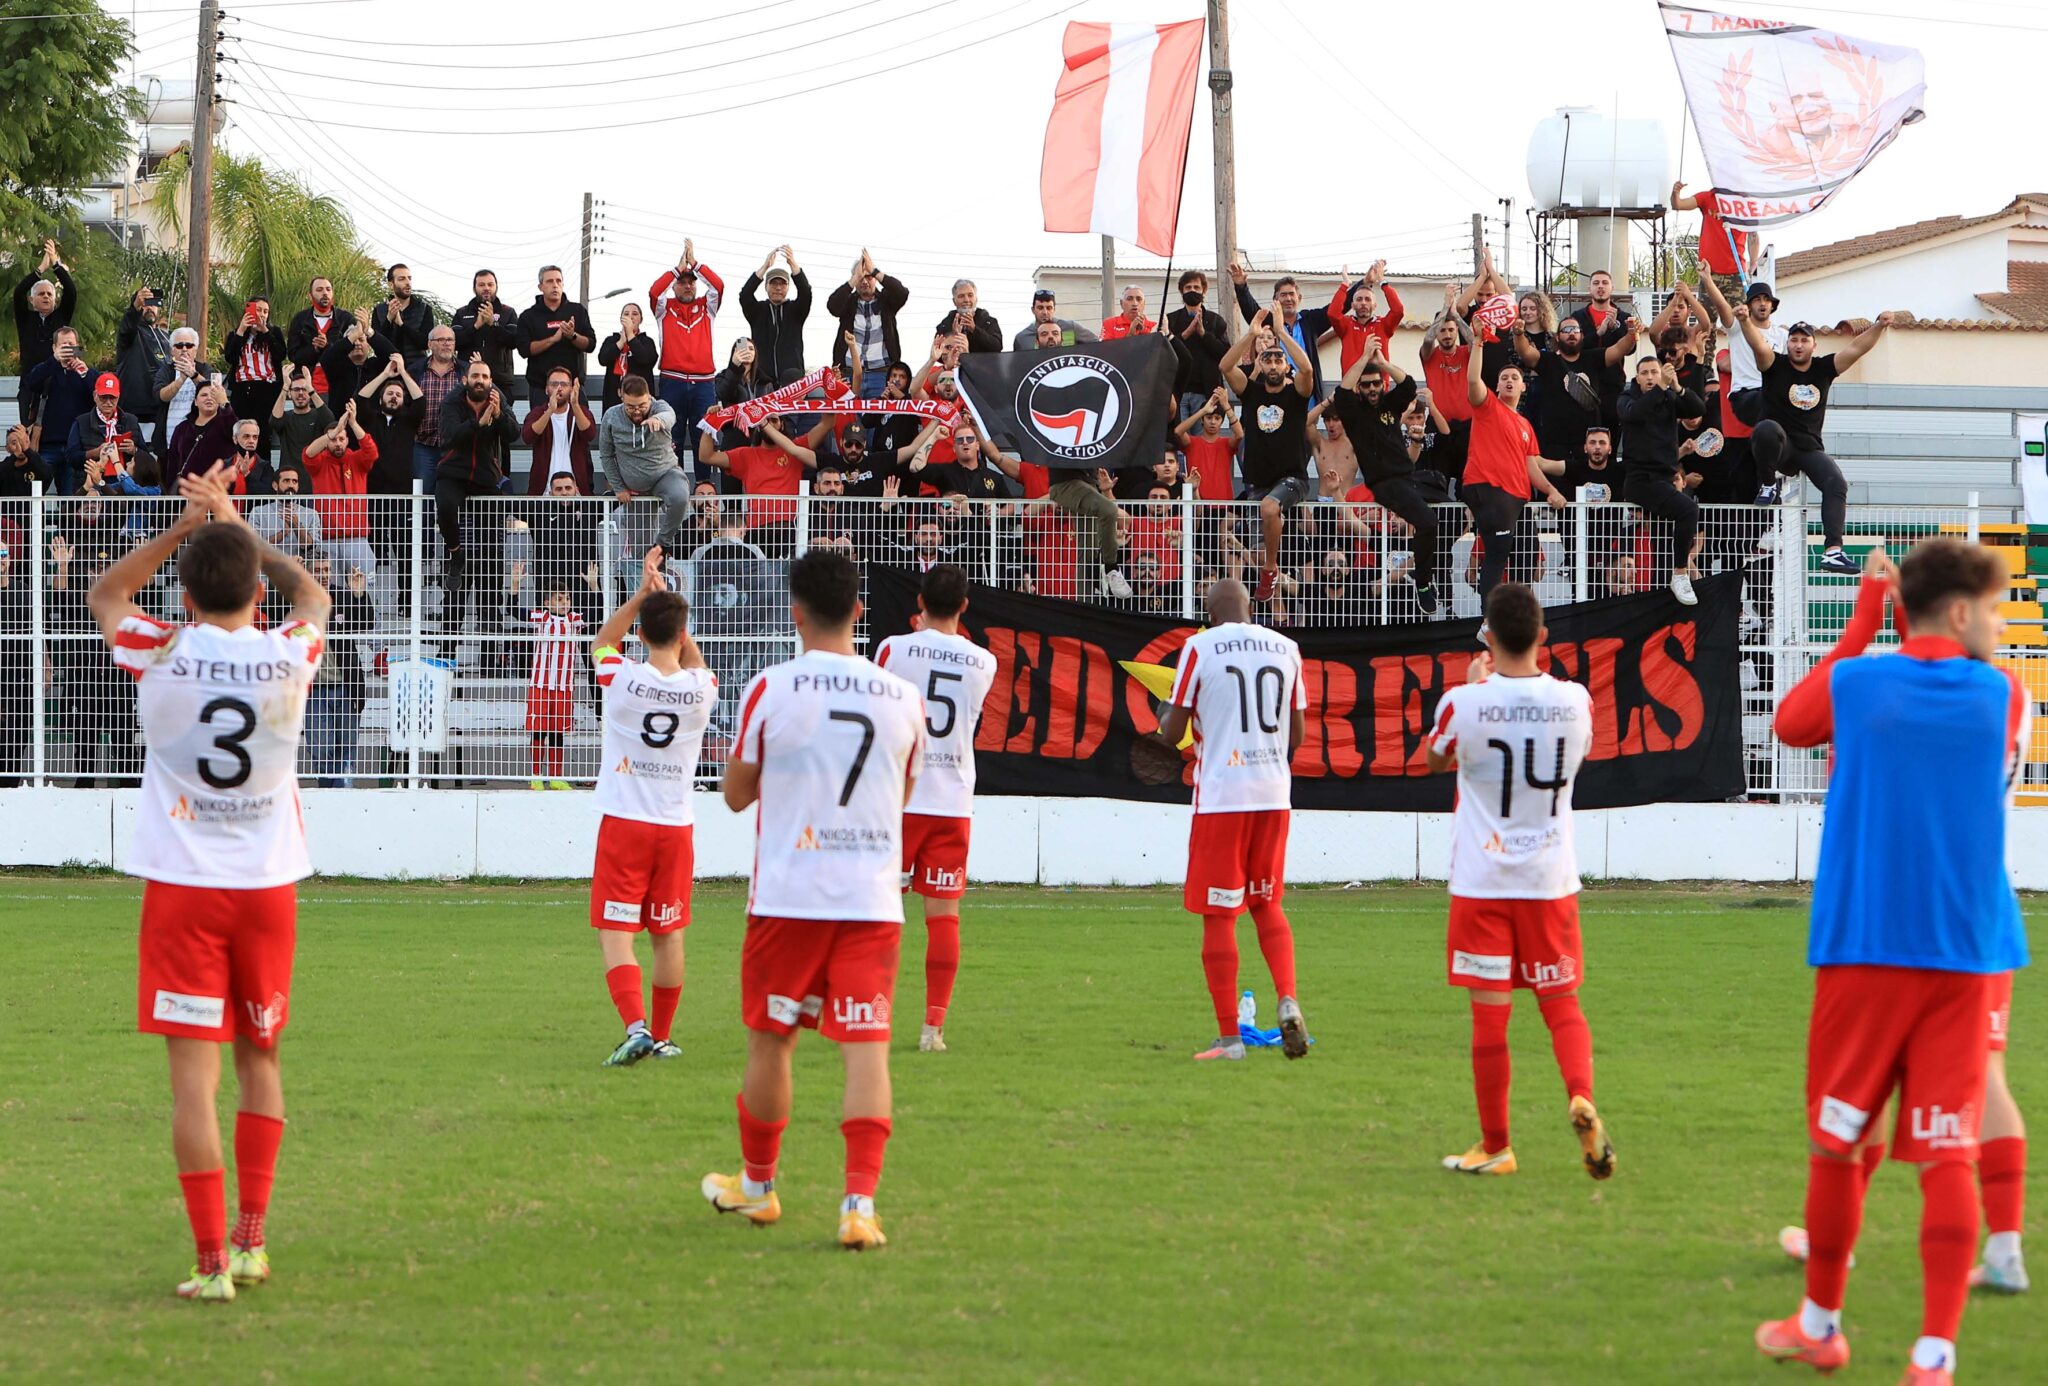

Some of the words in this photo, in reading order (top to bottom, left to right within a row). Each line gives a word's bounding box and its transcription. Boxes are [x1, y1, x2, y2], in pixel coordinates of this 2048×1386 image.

[1718, 198, 1798, 217] DREAM
[1028, 357, 1115, 386] ANTIFASCIST
[1054, 441, 1107, 458] ACTION
[908, 645, 985, 670] ANDREOU
[1214, 638, 1287, 655] DANILO
[172, 656, 292, 682] STELIOS
[627, 680, 704, 705] LEMESIOS
[793, 674, 903, 700] PAVLOU
[1225, 665, 1284, 734] 10
[925, 669, 962, 738] 5
[1478, 705, 1577, 722] KOUMOURIS
[197, 696, 256, 789] 3
[632, 760, 660, 773] NIKOS
[661, 764, 683, 775] PAPA
[829, 710, 875, 807] 7
[1488, 738, 1568, 818] 14
[193, 799, 237, 812] NIKOS
[241, 797, 273, 811] PAPA
[818, 828, 857, 842] NIKOS
[860, 829, 891, 842] PAPA
